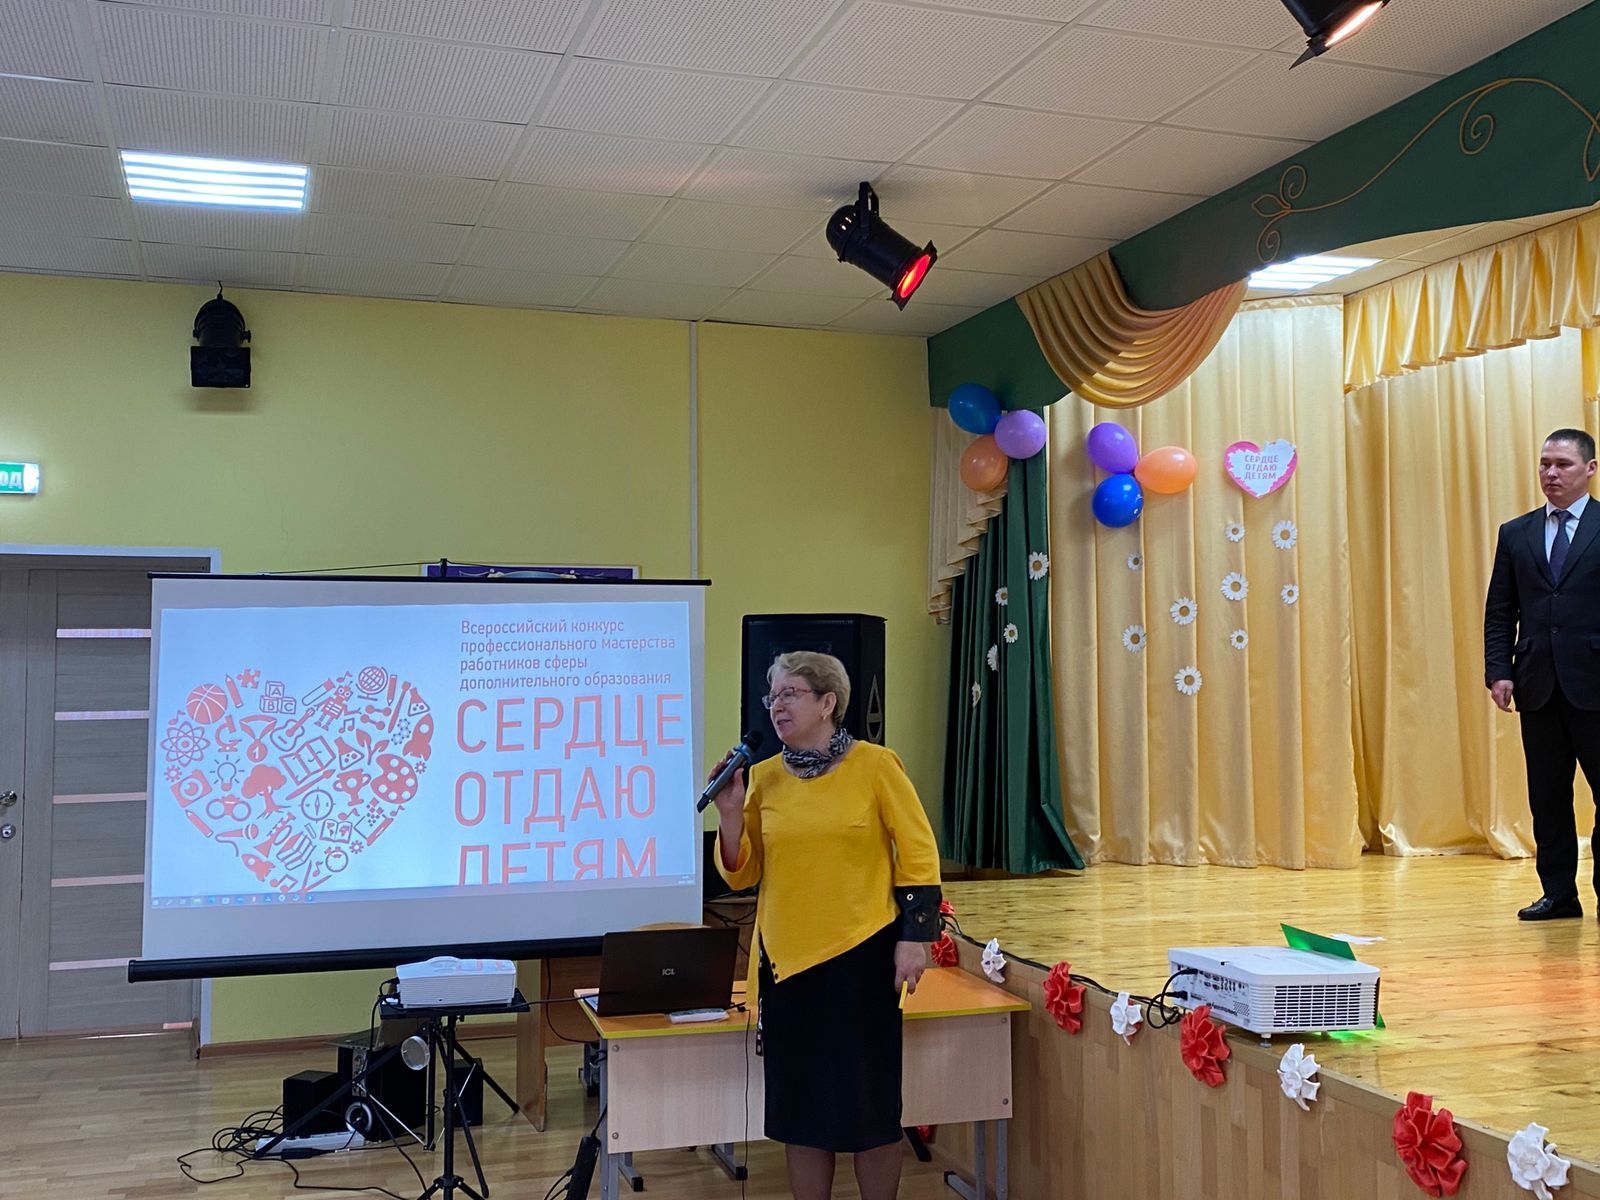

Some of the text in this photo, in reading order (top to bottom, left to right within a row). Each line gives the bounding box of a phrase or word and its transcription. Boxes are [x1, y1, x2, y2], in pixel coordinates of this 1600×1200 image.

[1244, 454, 1279, 464] СЕРДЦЕ
[1245, 463, 1277, 472] ОТДАЮ
[1244, 472, 1276, 480] ДЕТЯМ
[461, 619, 624, 637] Всероссийский конкурс
[460, 636, 675, 655] профессионального мастерства
[459, 655, 587, 674] работников сферы
[459, 671, 671, 691] дополнительного образования
[457, 693, 685, 760] СЕРДЦЕ
[455, 765, 656, 834] ОТДАЮ
